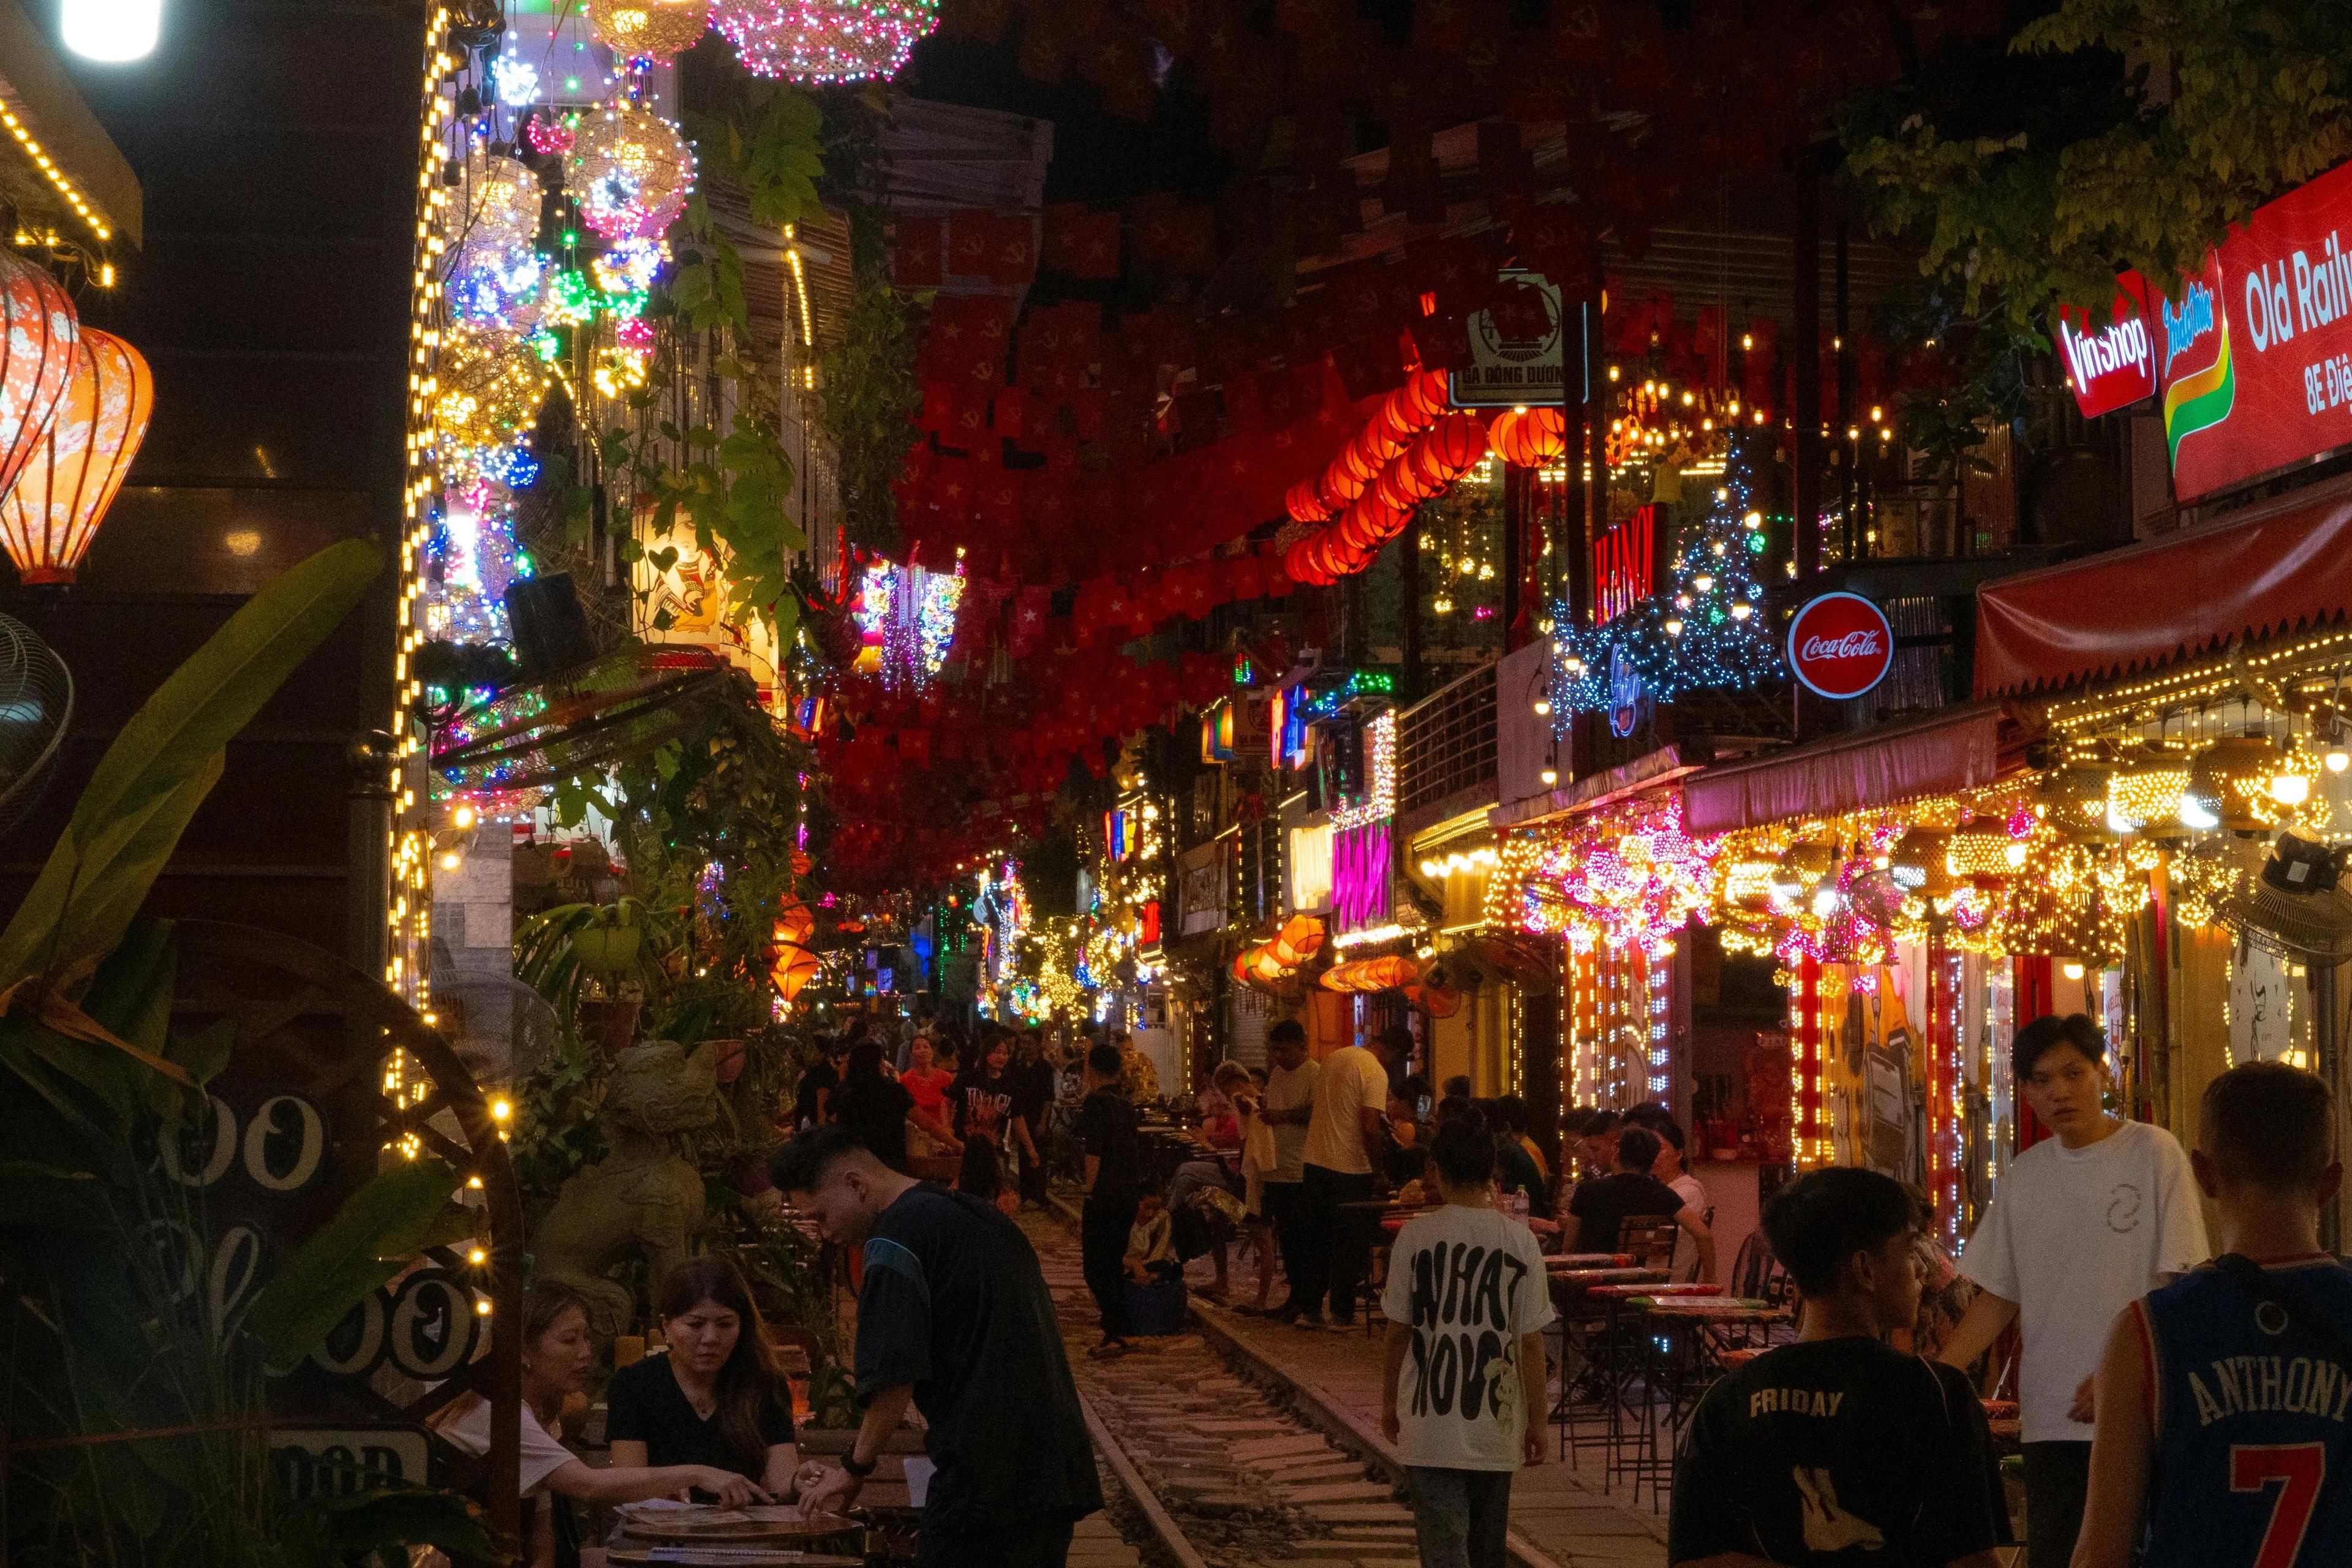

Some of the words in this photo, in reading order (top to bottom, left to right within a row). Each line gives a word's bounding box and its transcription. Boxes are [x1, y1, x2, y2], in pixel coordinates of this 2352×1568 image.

[2245, 259, 2293, 352] Old
[2304, 363, 2326, 415] 8E
[1801, 629, 1882, 662] Coca-Cola
[1411, 1240, 1528, 1334] WHAT
[1750, 1387, 1844, 1418] FRIDAY
[2187, 1355, 2352, 1427] ANTHONY
[2228, 1441, 2327, 1568] 7
